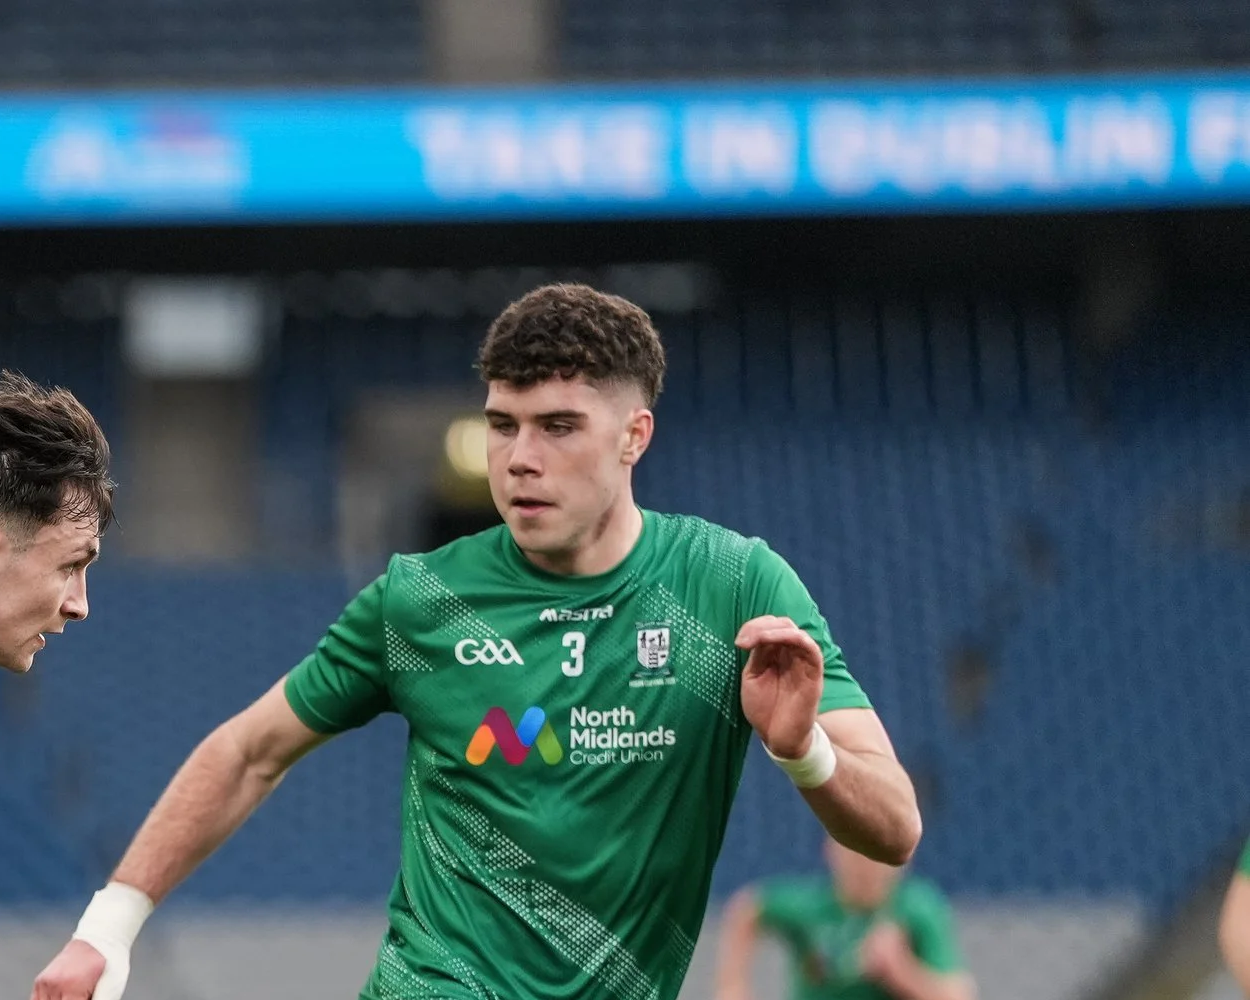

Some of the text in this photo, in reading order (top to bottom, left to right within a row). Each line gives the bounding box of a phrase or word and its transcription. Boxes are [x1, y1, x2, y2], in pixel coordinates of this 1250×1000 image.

[454, 638, 525, 666] GAA
[561, 631, 586, 677] 3
[570, 705, 636, 728] North
[570, 725, 677, 750] Midlands
[569, 749, 664, 766] Credit Union
